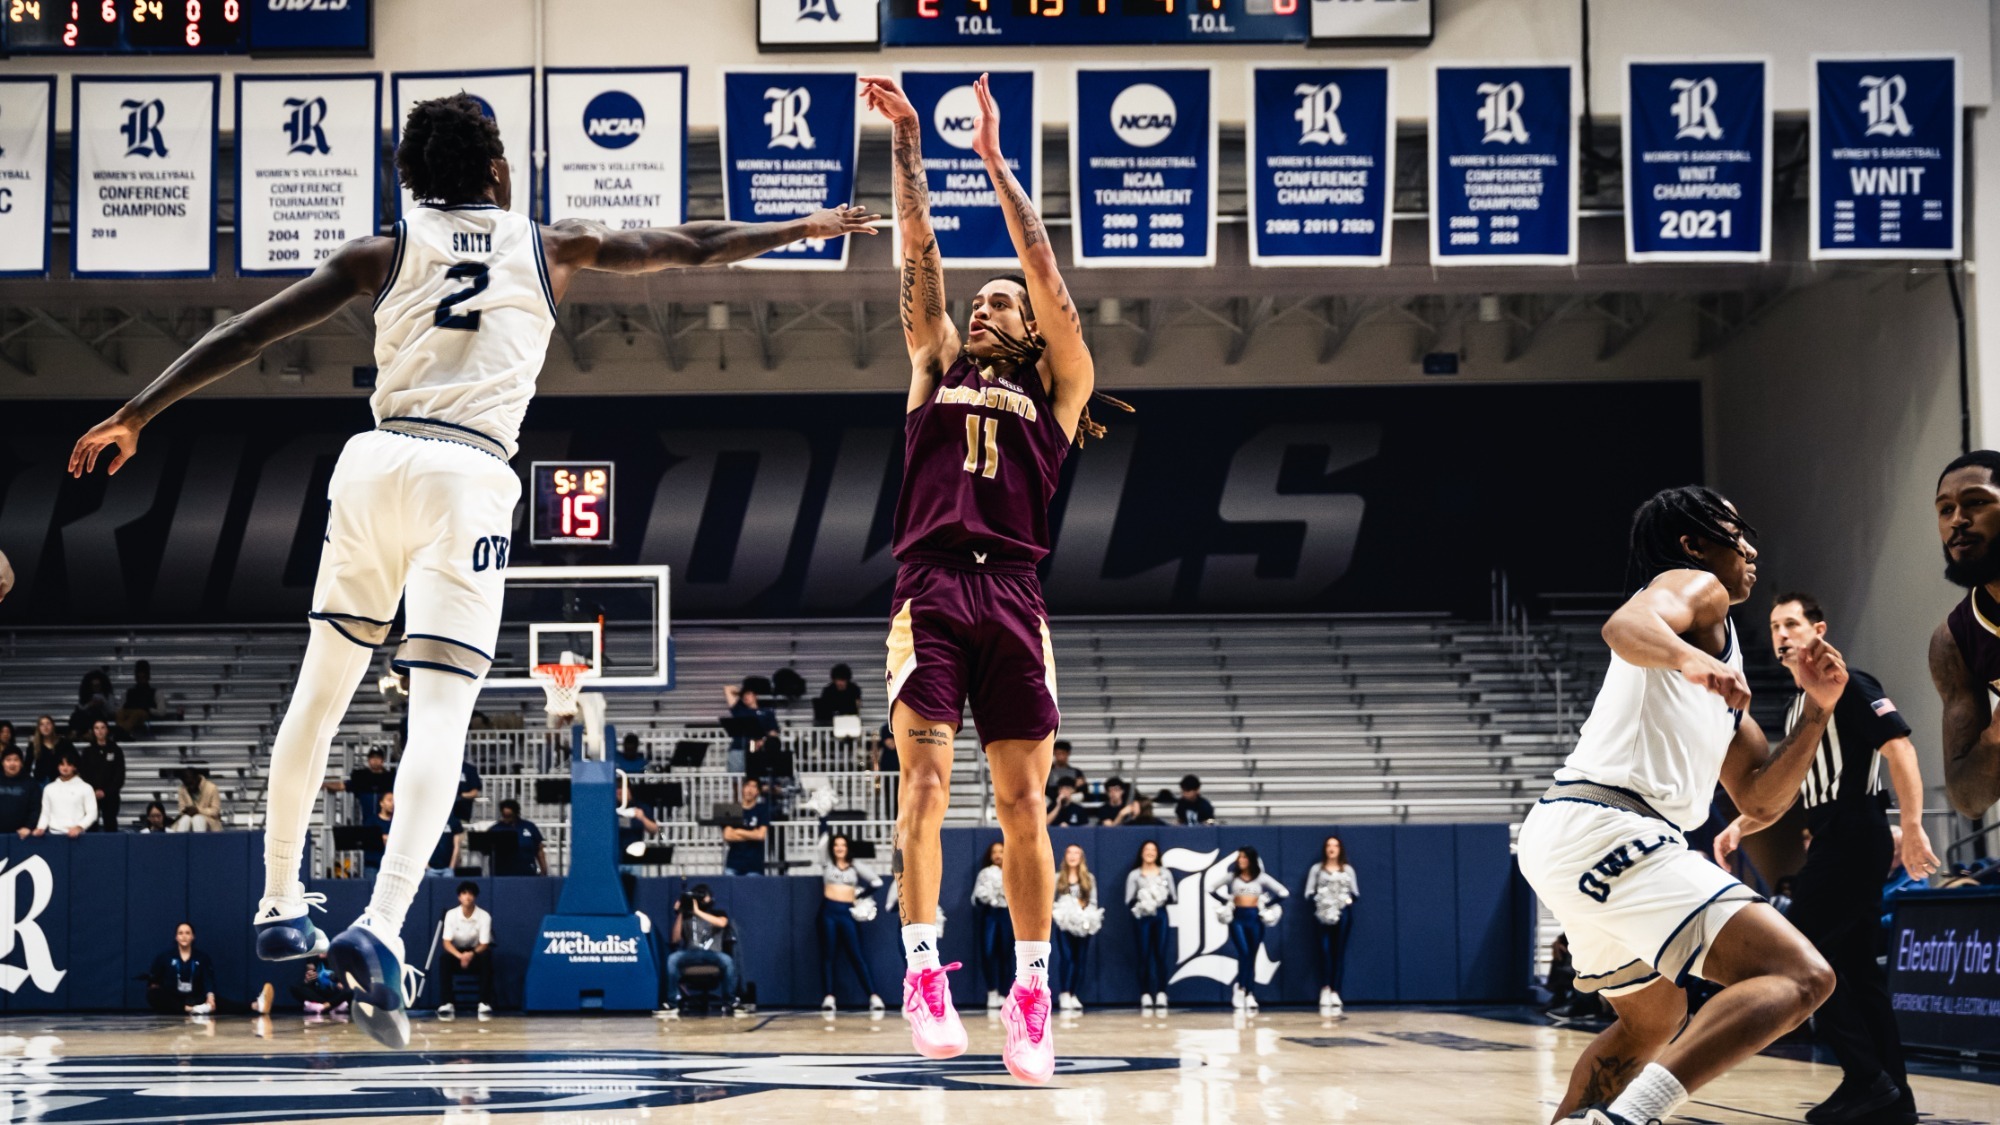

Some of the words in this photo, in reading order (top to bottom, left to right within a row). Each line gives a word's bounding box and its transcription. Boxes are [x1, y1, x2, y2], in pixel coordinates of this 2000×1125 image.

[63, 23, 78, 46] 2
[186, 23, 201, 46] 6
[587, 118, 644, 136] NCAA
[1119, 114, 1175, 129] NCAA
[609, 162, 665, 171] VOLLEYBALL
[783, 159, 842, 171] BASKETBALL
[922, 158, 958, 170] OMEN'S
[1137, 157, 1197, 168] BASKETBALL
[1314, 155, 1374, 168] BASKETBALL
[139, 170, 195, 180] VOLLEYBALL
[302, 168, 358, 177] VOLLEYBALL
[1274, 171, 1368, 187] CONFERENCE
[1465, 169, 1542, 182] CONFERENCE
[1678, 166, 1717, 182] WNIT
[594, 178, 632, 190] NCAA
[751, 173, 827, 187] CONFERENCE
[946, 174, 987, 189] NCAA
[1123, 172, 1164, 188] NCAA
[1850, 167, 1925, 195] WNIT
[99, 186, 190, 200] CONFERENCE
[270, 183, 344, 194] CONFERENCE
[750, 187, 828, 201] TOURNAMENT
[1464, 183, 1544, 196] TOURNAMENT
[1653, 183, 1742, 200] CHAMPIONS
[269, 197, 345, 207] TOURNAMENT
[567, 194, 661, 208] TOURNAMENT
[928, 191, 1001, 207] OURNAME
[1094, 189, 1193, 205] TOURNAMENT
[1277, 188, 1365, 205] CHAMPIONS
[102, 203, 186, 217] CHAMPIONS
[1468, 197, 1539, 211] CHAMPIONS
[273, 210, 341, 221] CHAMPIONS
[1659, 209, 1732, 239] 2021
[91, 228, 117, 239] 2018
[268, 230, 299, 241] 2004
[314, 229, 345, 240] 2018
[453, 232, 492, 253] SMITH
[268, 250, 300, 261] 2009
[314, 249, 337, 260] 20
[434, 260, 490, 332] 2
[986, 387, 1037, 422] STATE
[963, 413, 998, 480] 11
[554, 470, 607, 494] 5:12
[562, 495, 599, 536] 15
[544, 934, 638, 954] Methodist
[1897, 929, 1963, 985] Electrify
[1964, 929, 1992, 973] the
